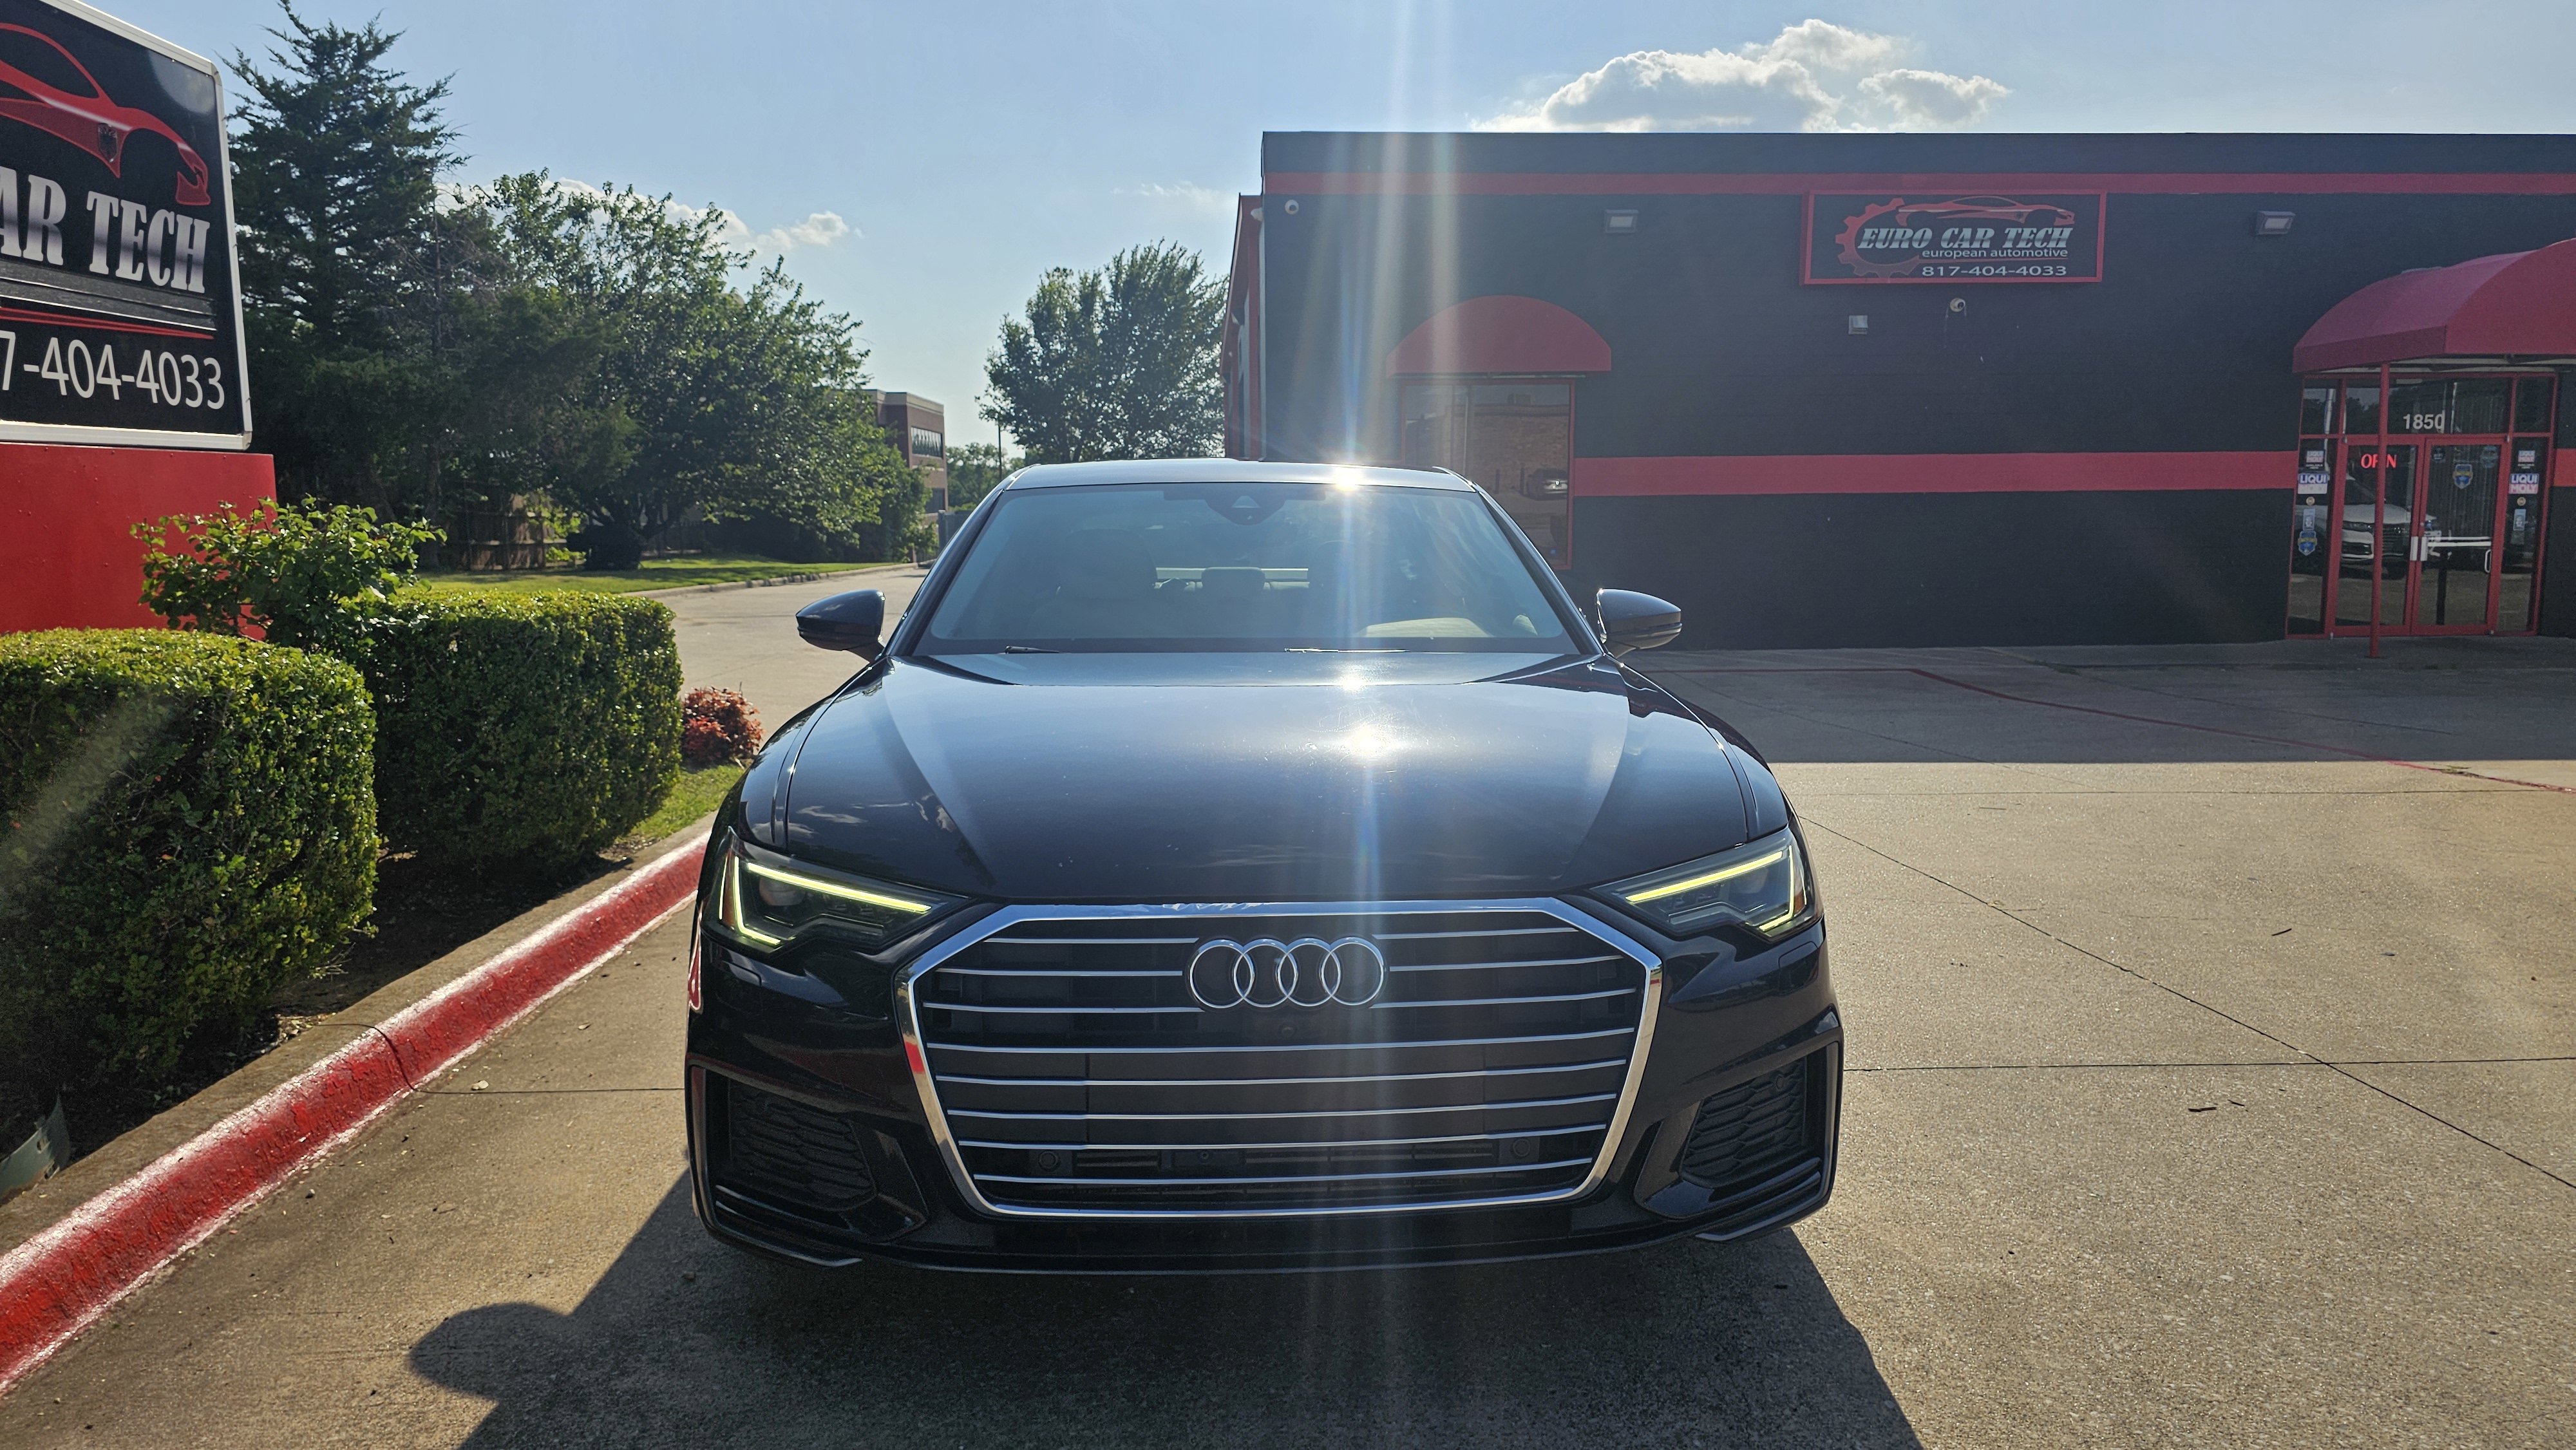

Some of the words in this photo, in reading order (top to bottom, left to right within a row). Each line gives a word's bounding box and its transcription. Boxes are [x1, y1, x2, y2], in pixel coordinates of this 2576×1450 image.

[86, 191, 211, 294] TECH
[1857, 228, 1933, 249] EURO
[1940, 227, 1995, 249] CAR
[2002, 227, 2073, 249] TECH
[1922, 249, 1987, 259] european
[1991, 248, 2068, 258] automotive
[1922, 265, 2067, 277] 817-404-4033
[0, 330, 225, 410] 7-404-4033
[2403, 413, 2445, 430] 1850
[2300, 475, 2327, 484] LIQUI
[2512, 474, 2538, 484] LIQUI
